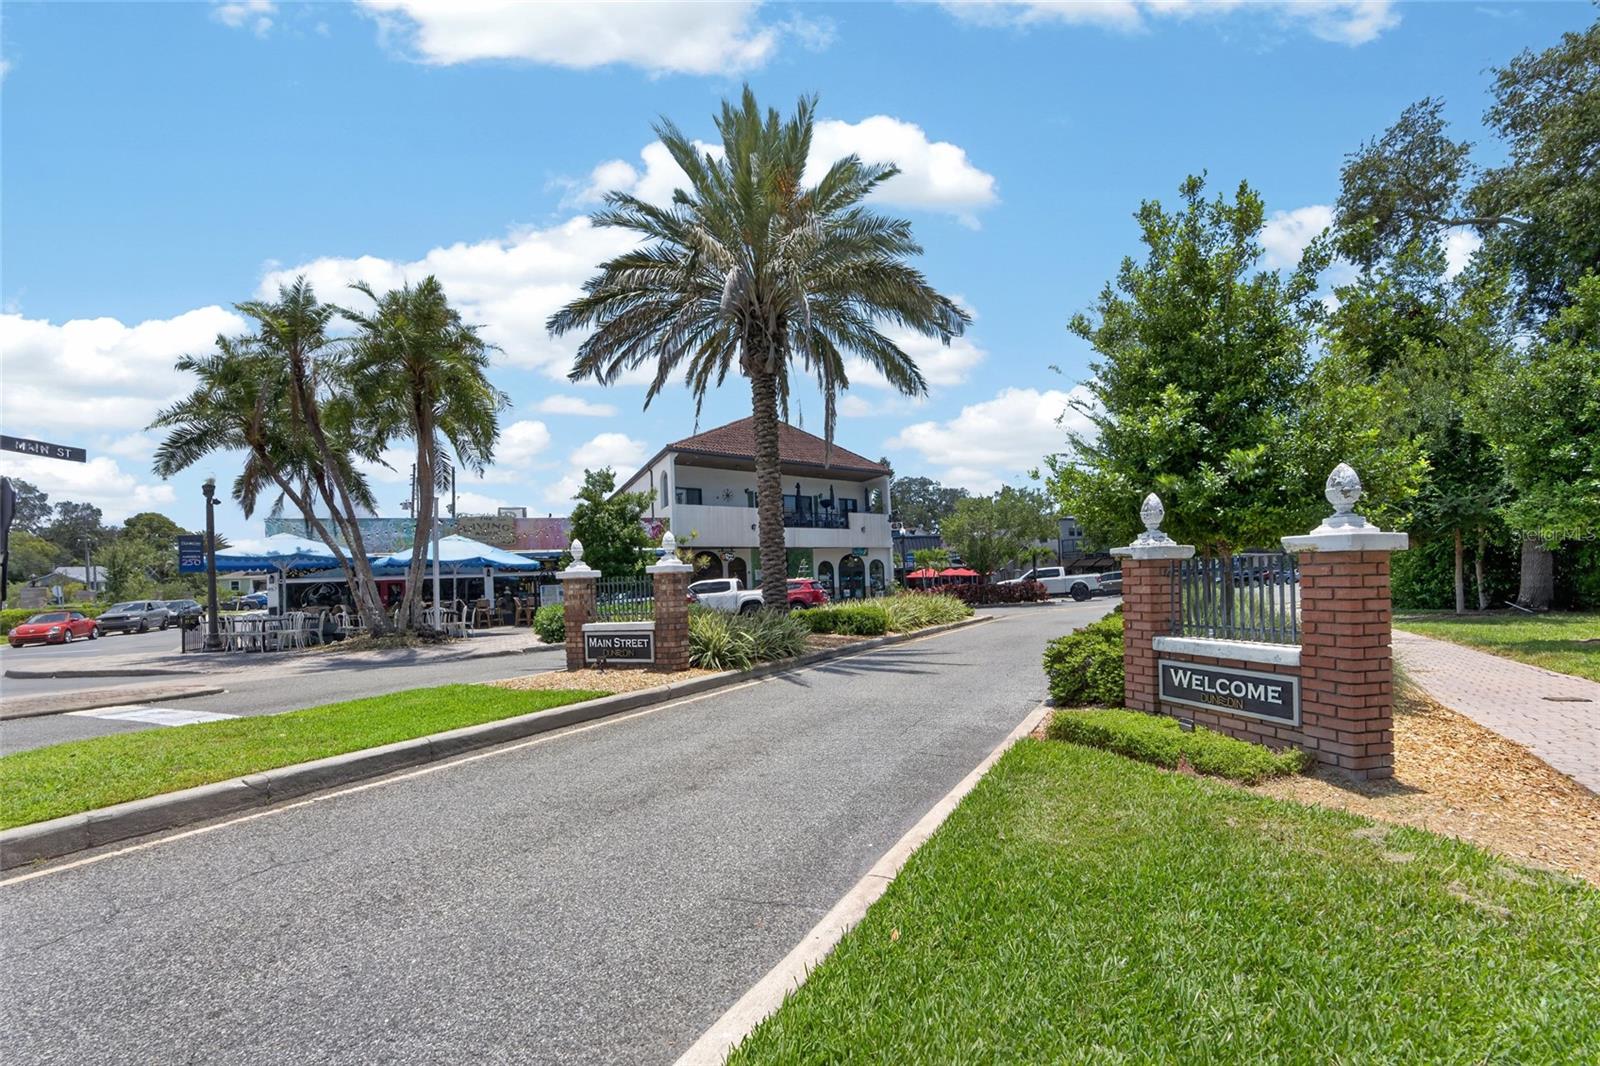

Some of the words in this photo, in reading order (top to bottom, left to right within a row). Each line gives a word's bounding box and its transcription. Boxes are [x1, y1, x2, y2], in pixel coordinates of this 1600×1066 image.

[15, 441, 49, 454] MAIN
[56, 448, 72, 458] ST
[589, 637, 612, 647] MAIN
[614, 637, 649, 647] STREET
[1170, 668, 1282, 705] WELCOME
[1201, 692, 1244, 709] DUNEDIN
